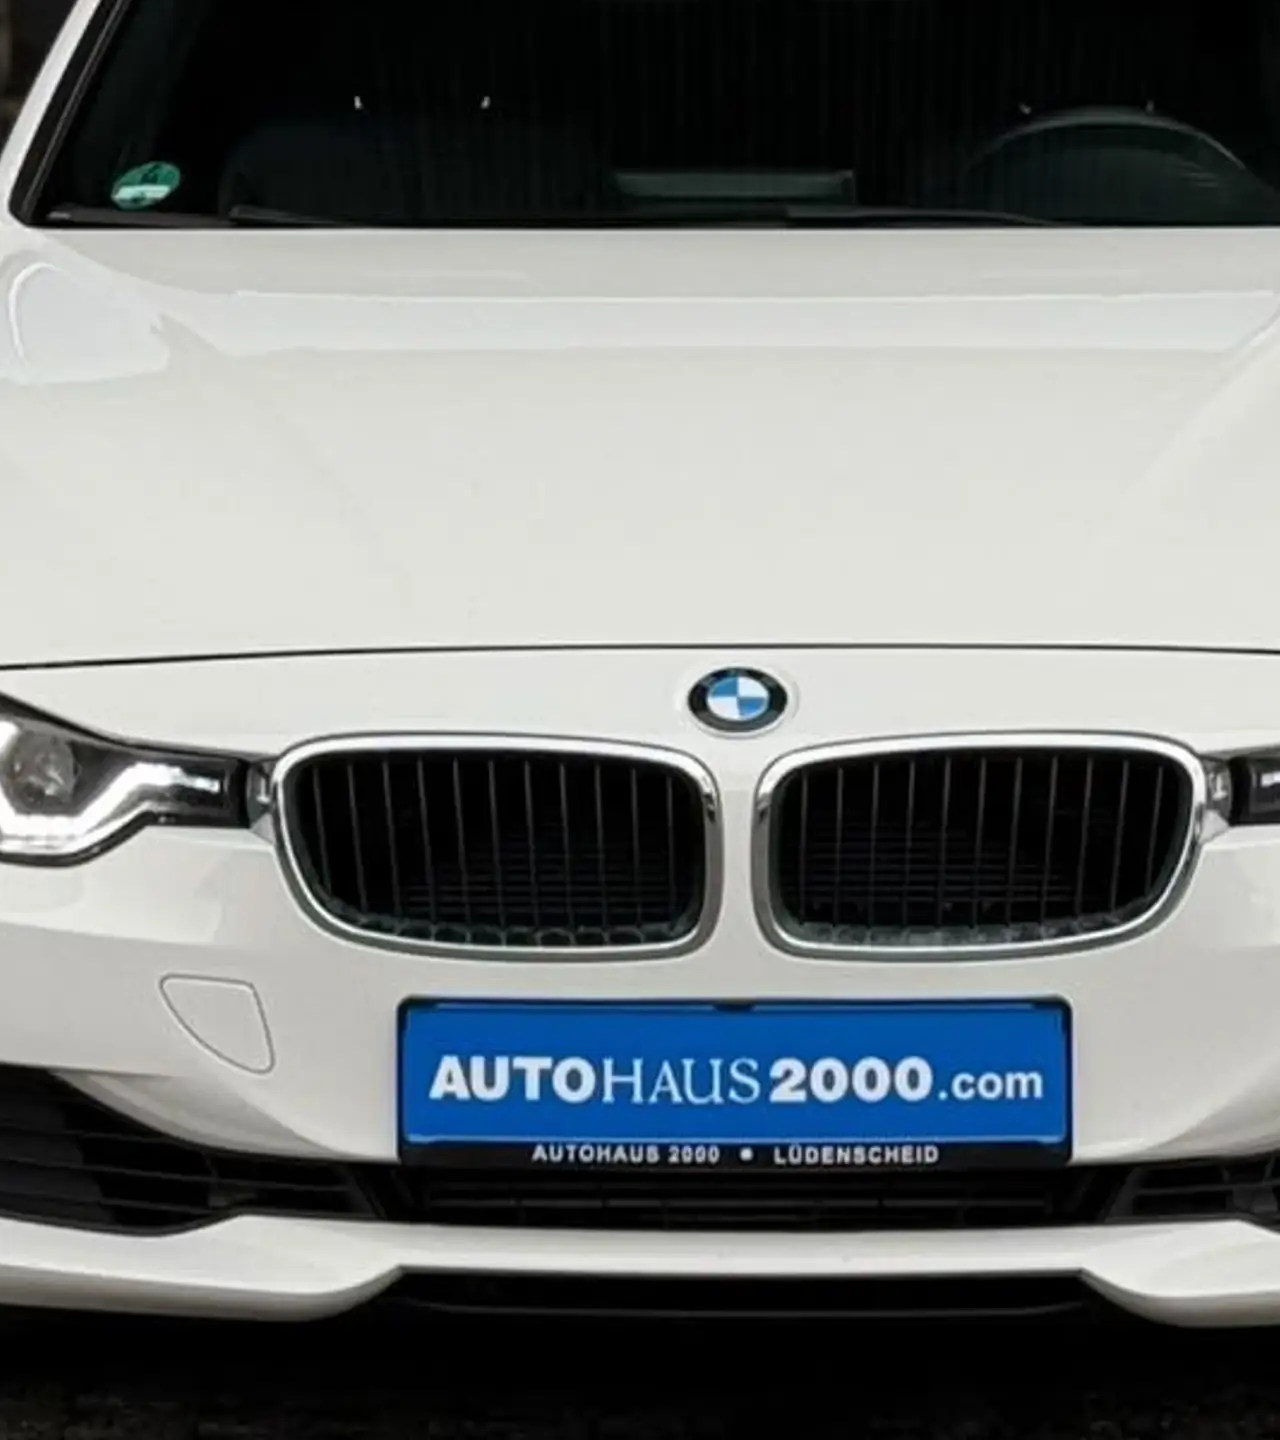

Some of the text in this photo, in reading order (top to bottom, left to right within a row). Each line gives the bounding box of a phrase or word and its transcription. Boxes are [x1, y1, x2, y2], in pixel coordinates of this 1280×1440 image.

[531, 1141, 940, 1166] AUTOHAUS 2000 LÜDENSCHEID
